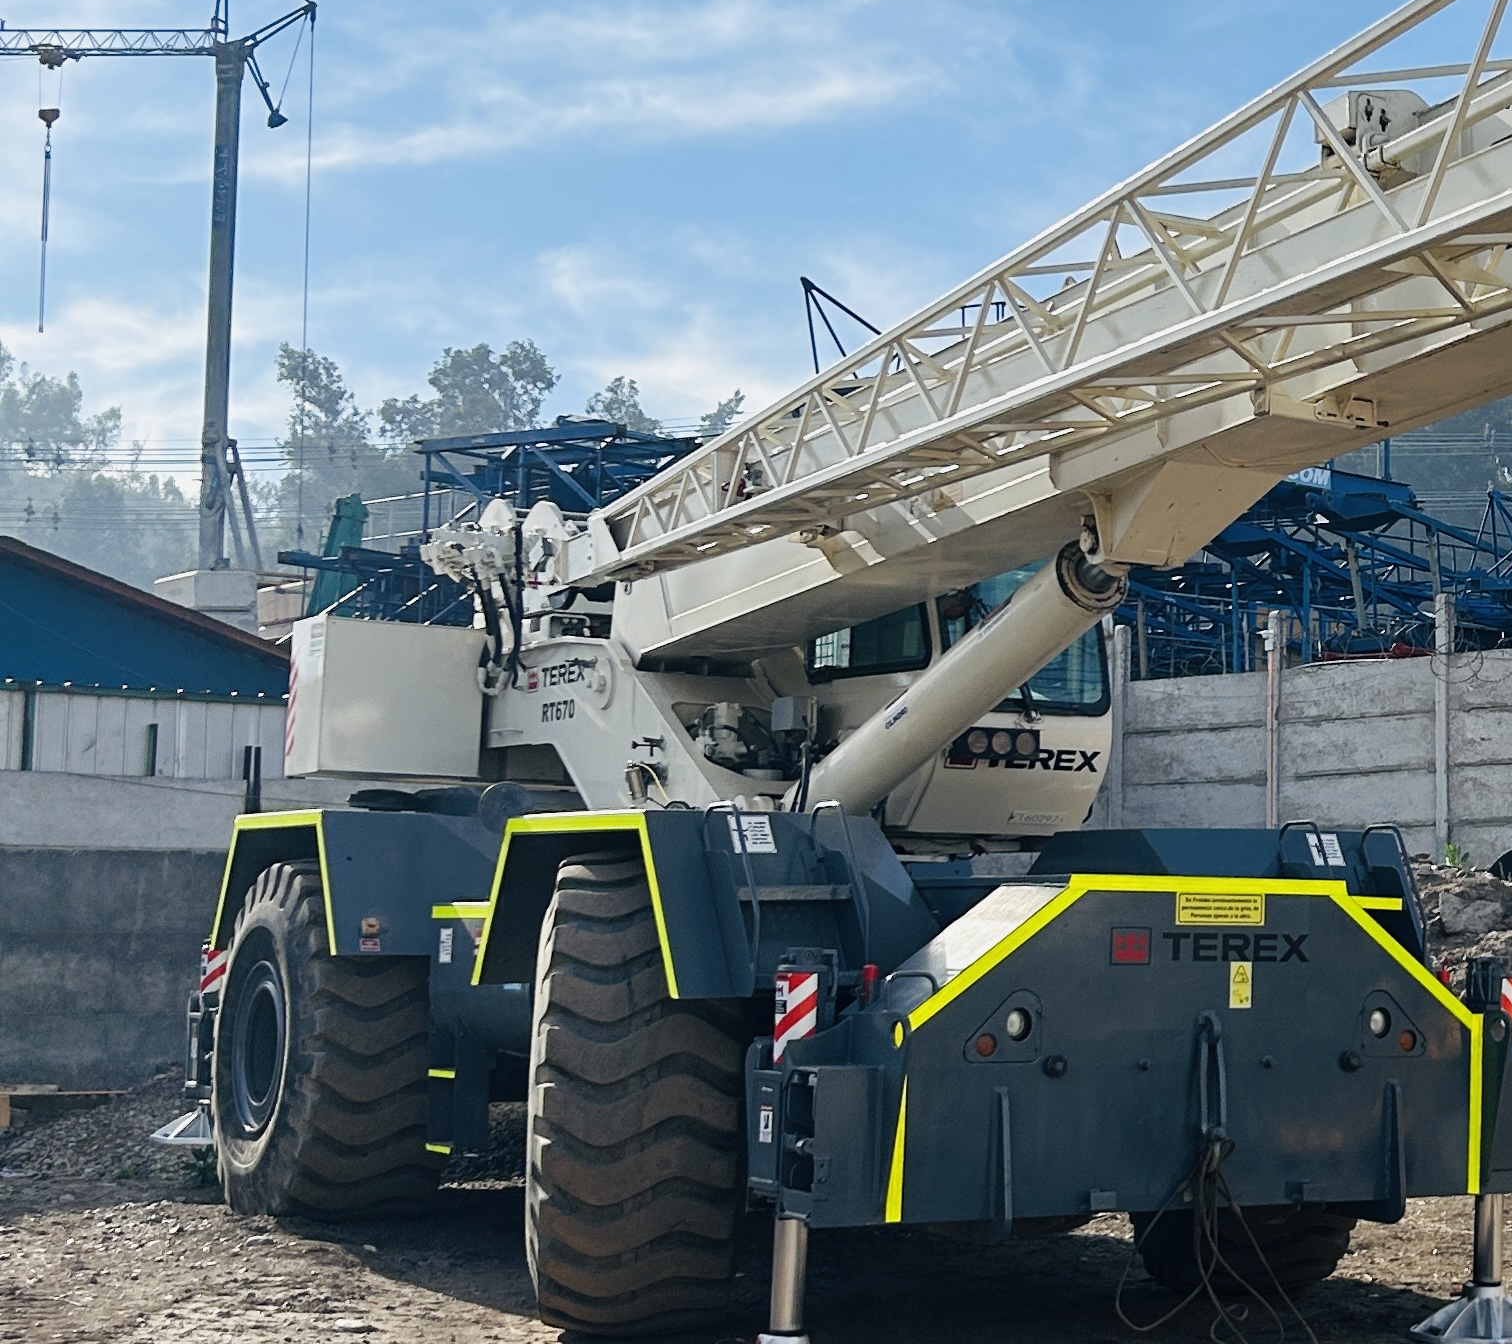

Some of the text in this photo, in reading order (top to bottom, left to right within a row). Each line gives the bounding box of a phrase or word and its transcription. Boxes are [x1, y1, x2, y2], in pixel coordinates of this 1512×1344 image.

[541, 663, 586, 688] TEREX
[541, 698, 576, 724] RT670
[1162, 932, 1310, 963] TEREX
